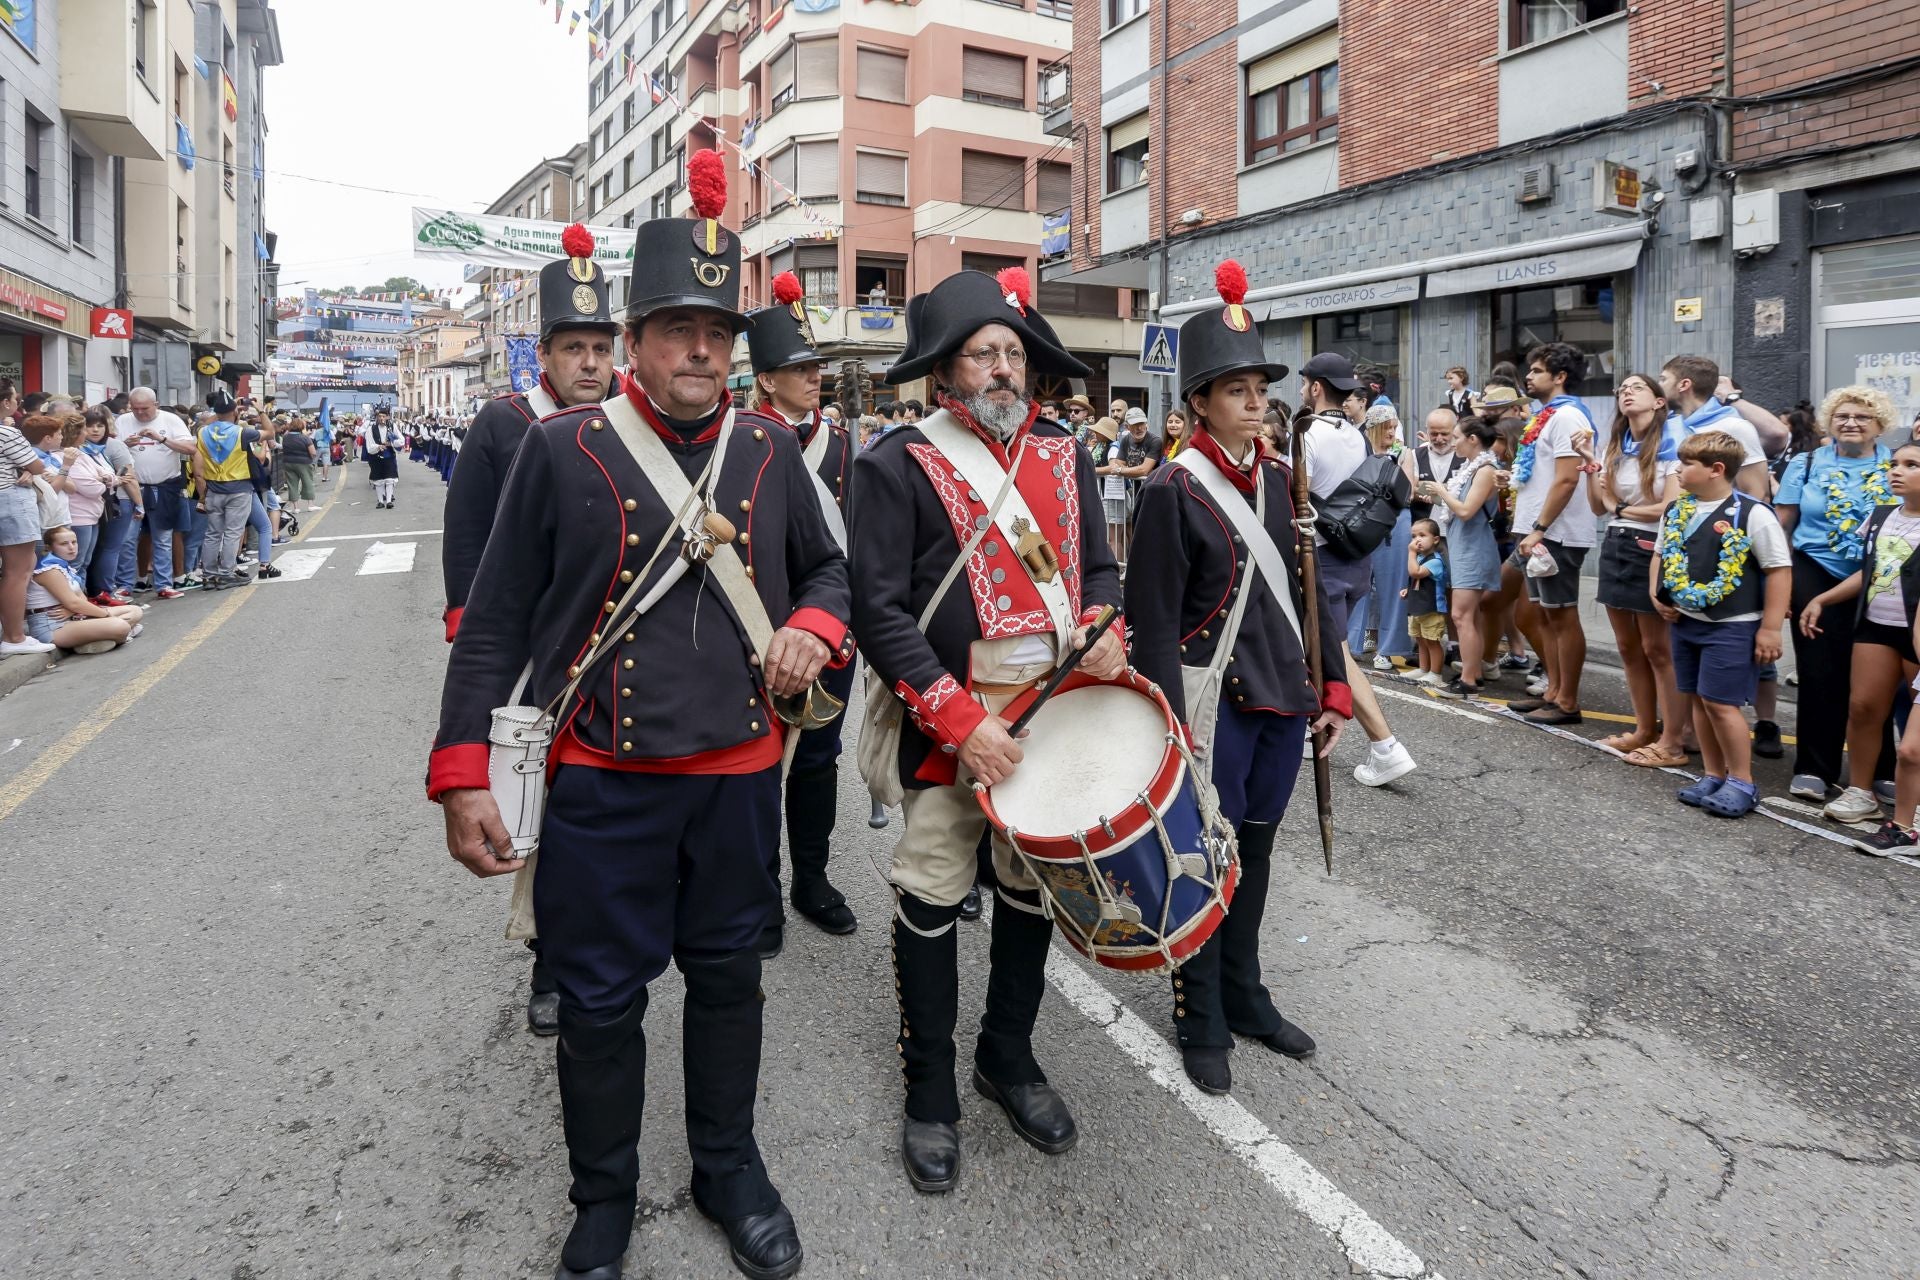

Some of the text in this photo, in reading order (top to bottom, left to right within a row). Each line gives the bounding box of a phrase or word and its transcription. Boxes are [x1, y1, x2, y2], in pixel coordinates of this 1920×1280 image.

[425, 224, 479, 243] Cuevas
[503, 225, 563, 241] Agua miner
[494, 238, 620, 260] de la montañ riana
[1496, 259, 1557, 283] LLANES
[1304, 287, 1376, 310] FOTOGRAFOS
[335, 334, 372, 344] TIERRA
